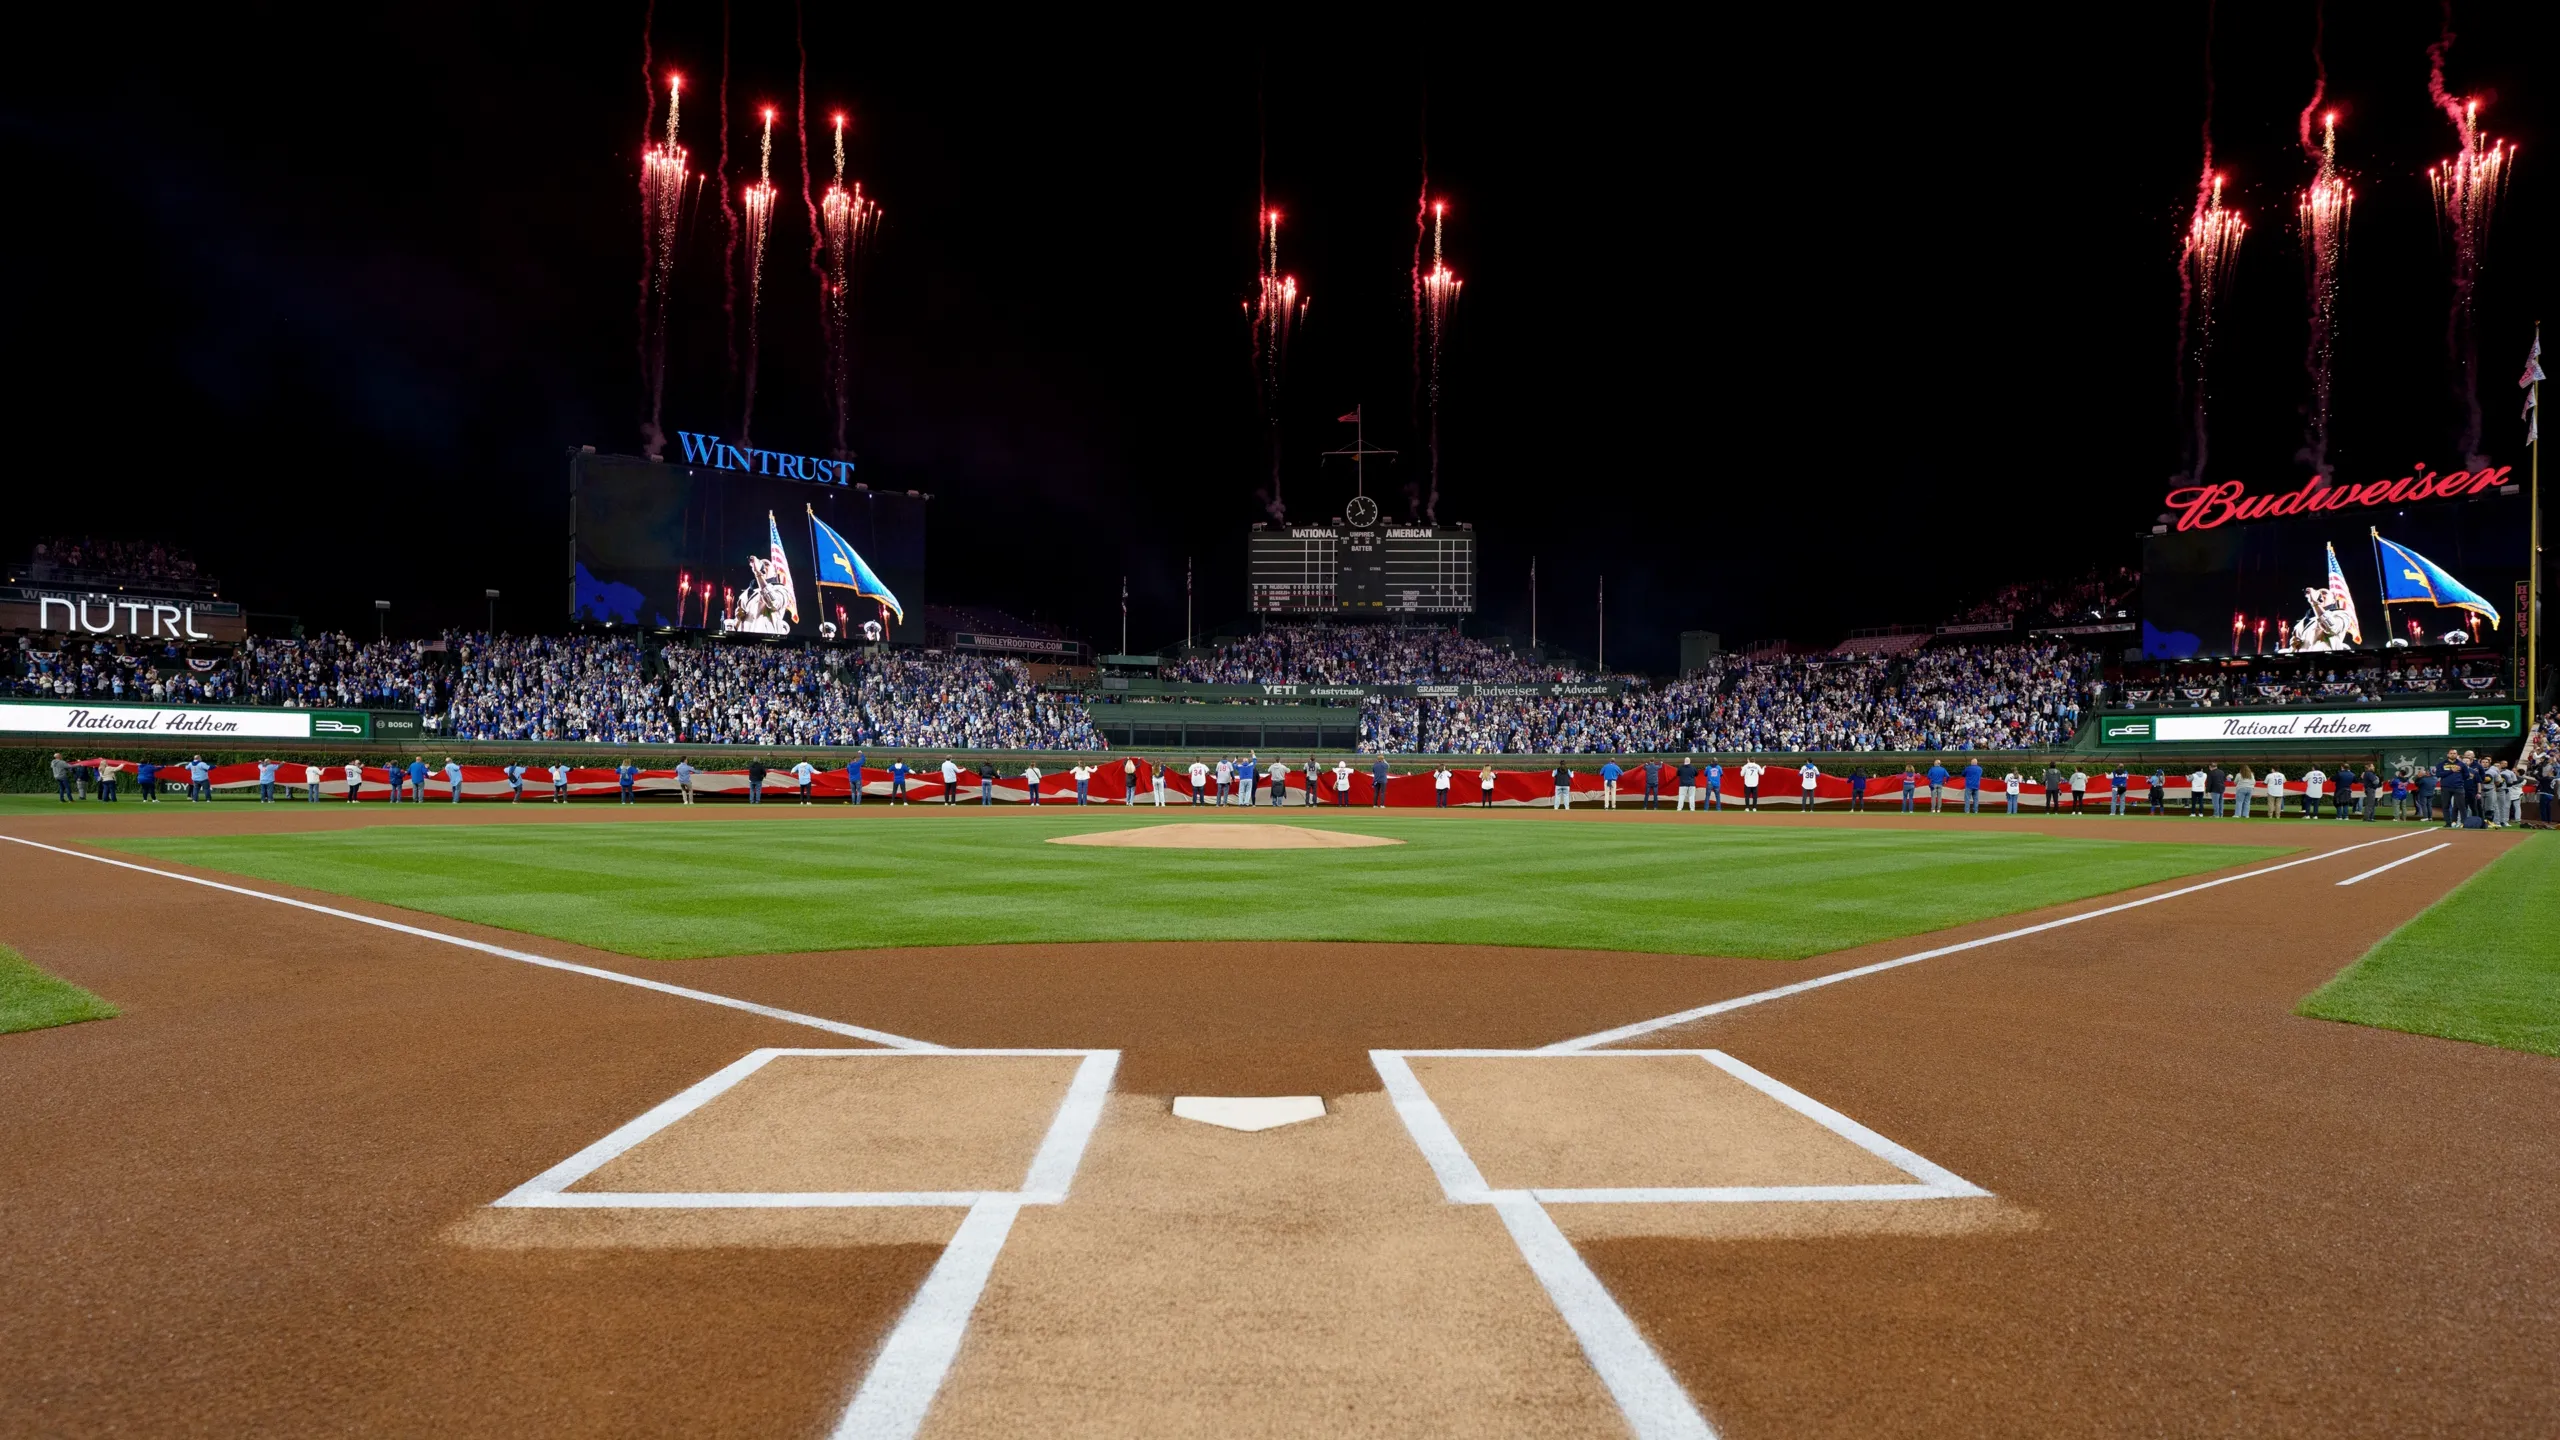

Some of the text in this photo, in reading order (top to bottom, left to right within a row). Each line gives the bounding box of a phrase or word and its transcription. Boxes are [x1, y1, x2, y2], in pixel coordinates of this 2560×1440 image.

[677, 431, 855, 486] WINTRUST
[2165, 462, 2512, 532] Budweiser
[1292, 529, 1338, 538] NATIONAL
[1386, 529, 1432, 538] AMERICAN
[21, 589, 213, 612] WRIGLEYROOFTOPSCOM
[2517, 585, 2529, 610] Hey
[40, 593, 209, 639] NÜTRL
[2517, 612, 2529, 637] Hey
[974, 636, 1063, 651] WRIGLEYROOFTOPS.COM
[1263, 685, 1297, 695] YETI
[1317, 687, 1365, 696] tastytrade
[1417, 685, 1459, 693] GRAINGER
[1473, 685, 1537, 696] Budweiser
[1564, 685, 1607, 694] Advocate
[68, 709, 240, 732] National Anthem
[388, 720, 413, 729] BOSCH
[2222, 716, 2372, 736] National Anthem
[1193, 769, 1203, 777] 34
[2274, 778, 2283, 786] 16
[2312, 776, 2323, 784] 33
